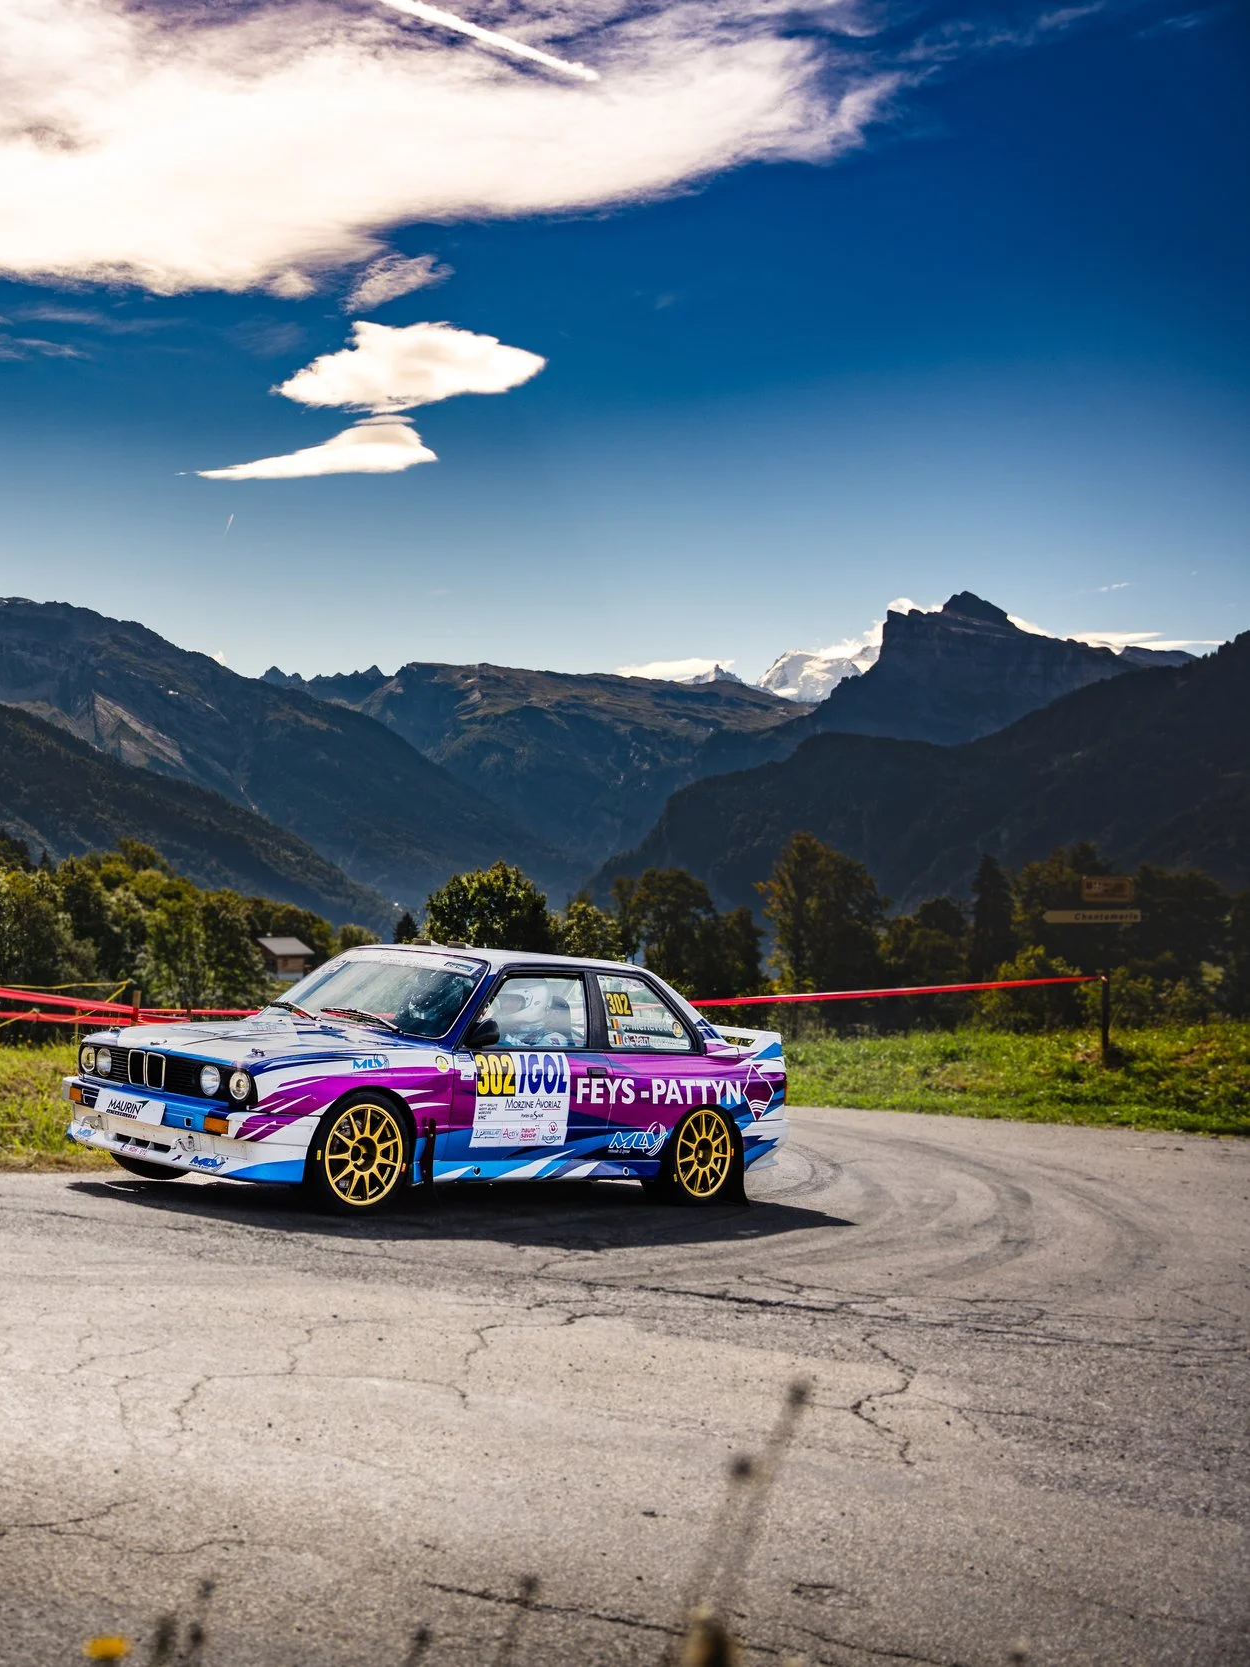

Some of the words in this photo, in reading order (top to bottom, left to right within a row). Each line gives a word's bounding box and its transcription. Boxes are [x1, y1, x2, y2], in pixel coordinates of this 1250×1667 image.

[605, 992, 632, 1015] 302
[475, 1053, 516, 1096] 302
[518, 1053, 568, 1095] IGOL
[107, 1098, 142, 1115] MAURIN
[609, 1131, 668, 1149] MLV
